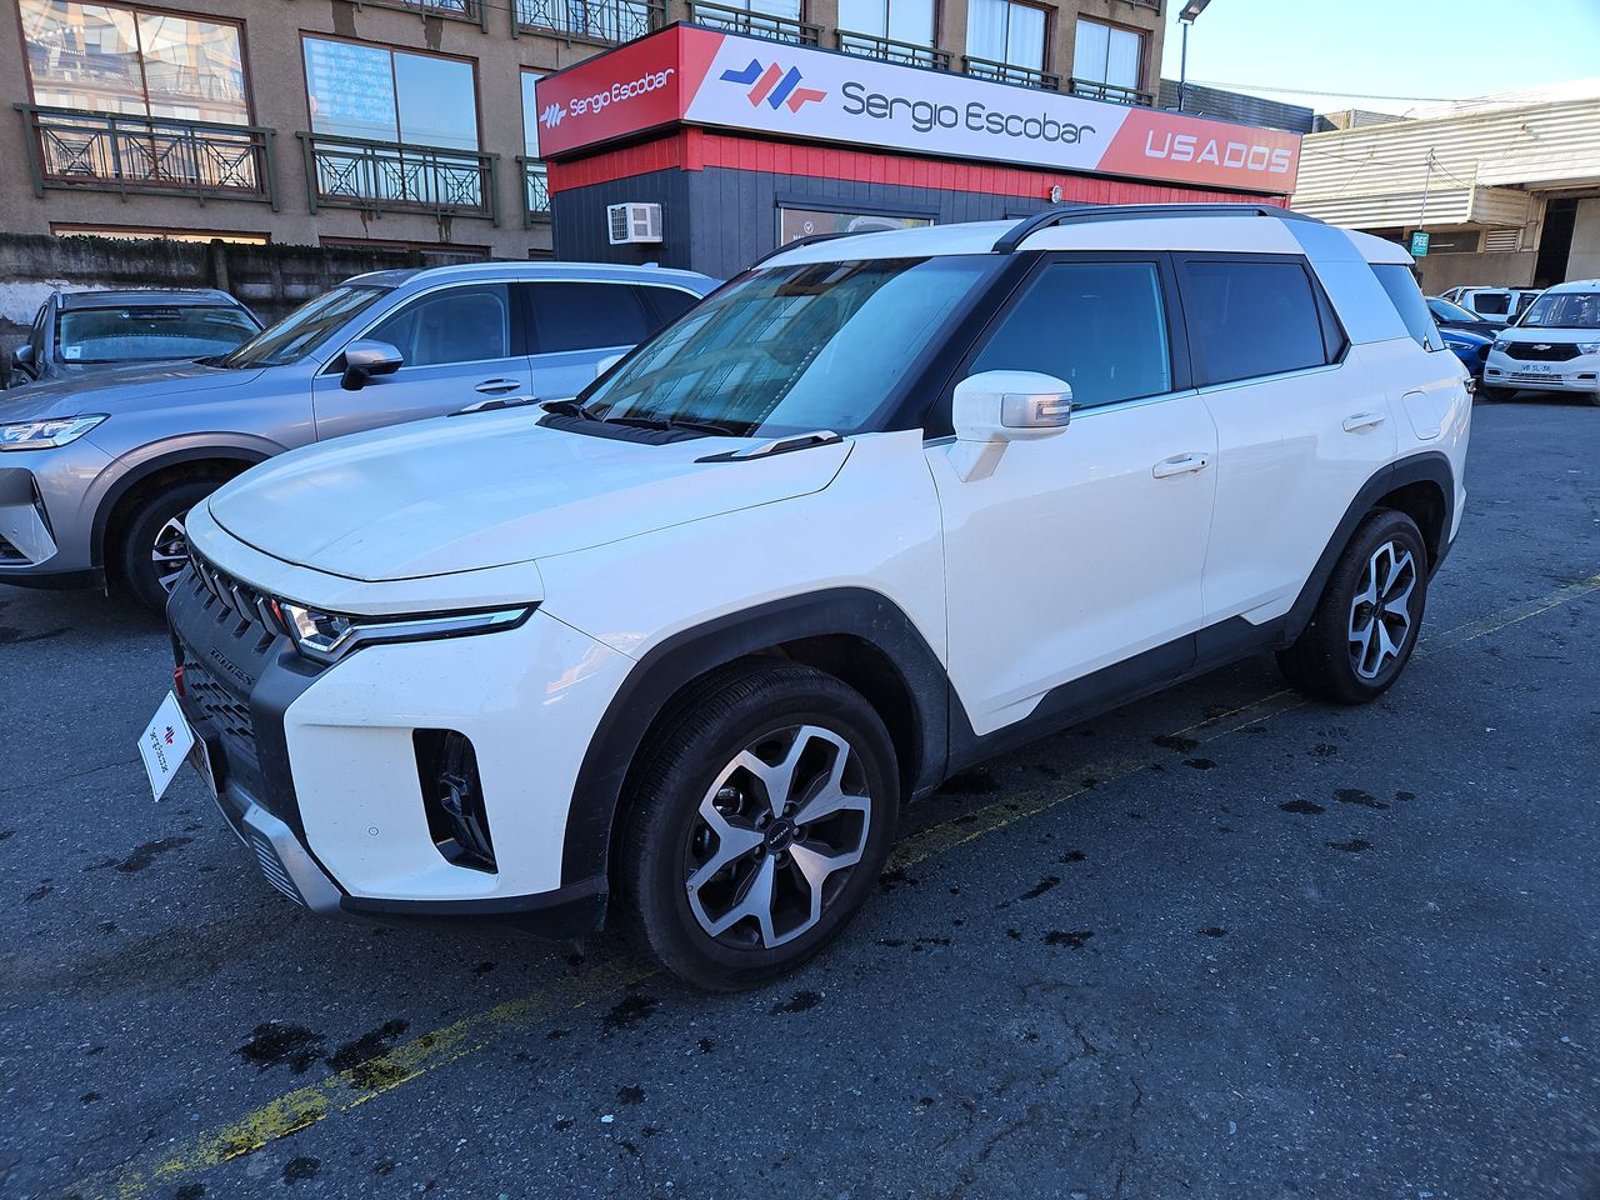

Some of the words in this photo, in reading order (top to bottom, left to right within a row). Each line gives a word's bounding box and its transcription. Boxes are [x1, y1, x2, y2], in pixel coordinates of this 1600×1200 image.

[611, 68, 675, 102] Escobar
[841, 81, 958, 133] Sergio
[965, 101, 1096, 144] Escobar
[1145, 129, 1292, 173] USADOS
